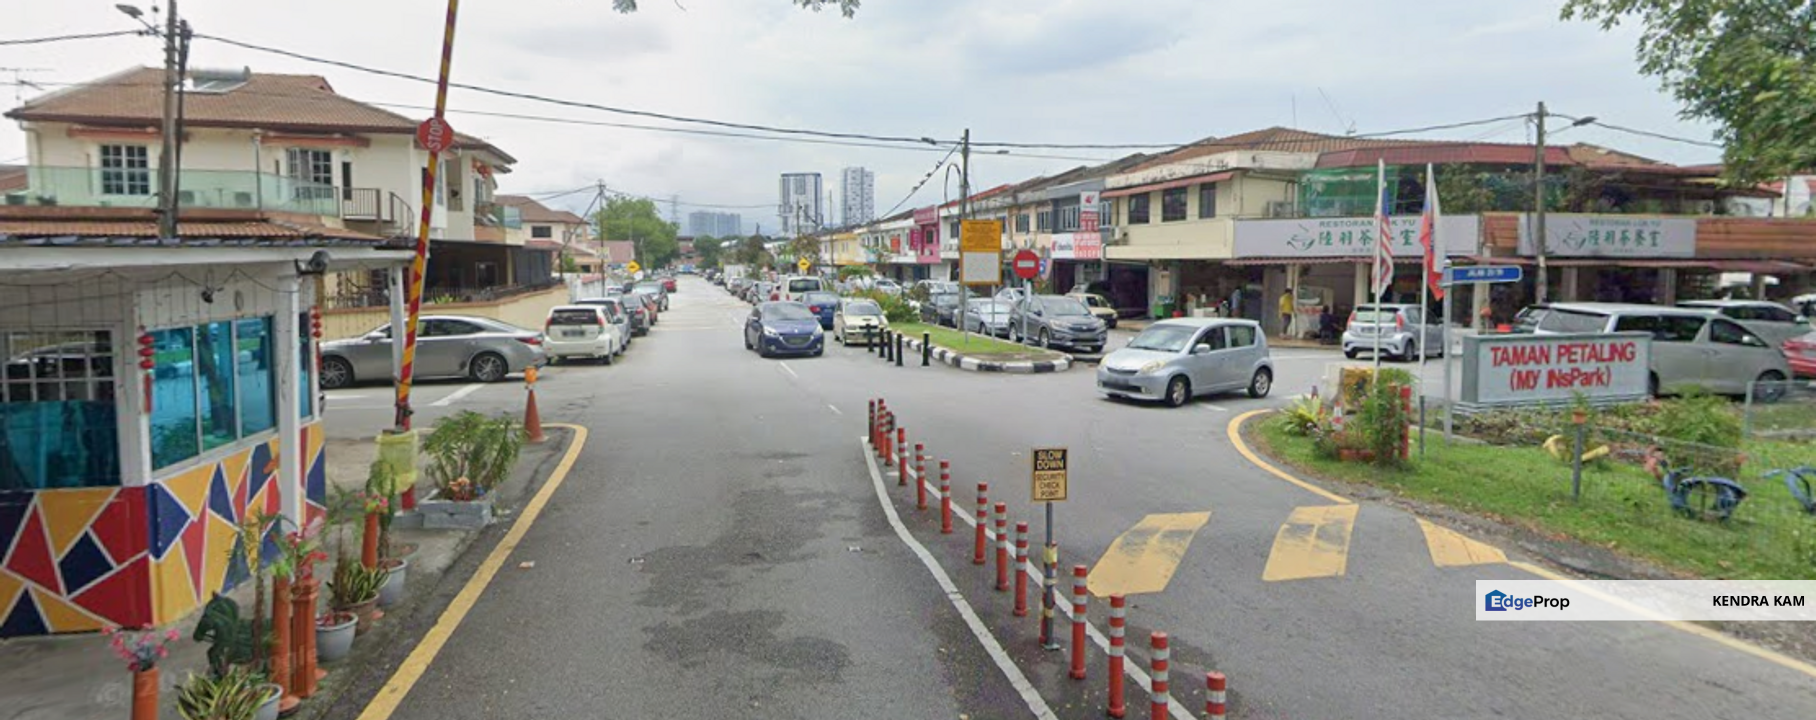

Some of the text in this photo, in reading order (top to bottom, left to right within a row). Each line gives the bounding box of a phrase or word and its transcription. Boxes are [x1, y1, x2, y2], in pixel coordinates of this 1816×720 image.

[427, 119, 443, 150] STOP
[1319, 219, 1373, 228] RESTORAN
[1401, 218, 1416, 227] YU
[1319, 228, 1416, 247] 陸羽茶室
[1490, 341, 1636, 367] TAMAN PETALING
[1510, 368, 1541, 391] (MY
[1036, 459, 1064, 470] DOWN
[1037, 450, 1063, 460] SLOW
